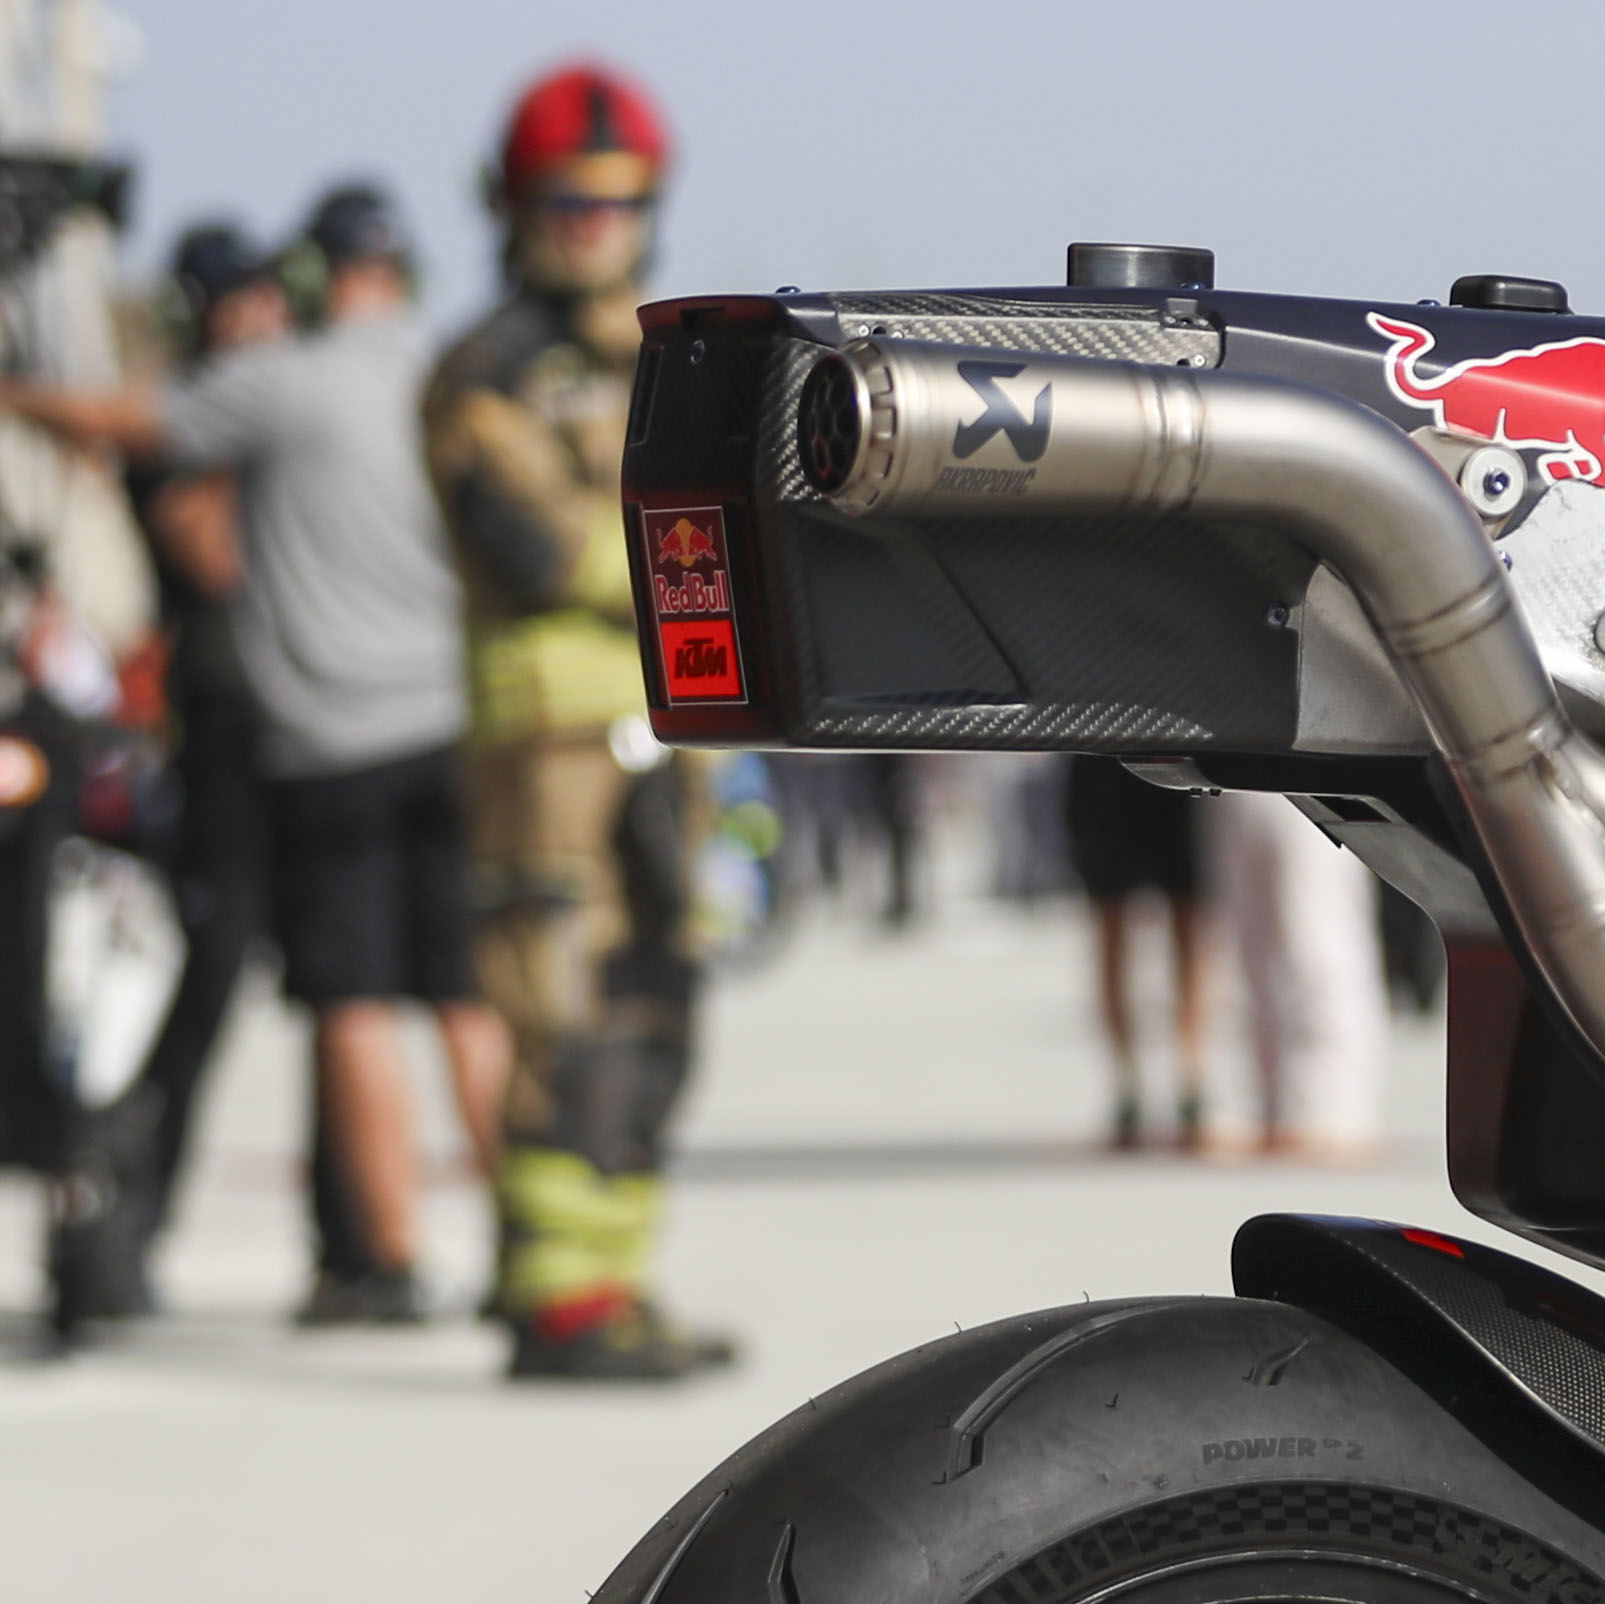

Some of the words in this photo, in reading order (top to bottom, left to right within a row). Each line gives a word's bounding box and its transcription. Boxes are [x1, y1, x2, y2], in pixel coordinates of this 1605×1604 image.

[654, 571, 693, 614] Red
[688, 569, 730, 613] Bull
[674, 637, 728, 679] KTM
[1202, 1432, 1317, 1465] POWER
